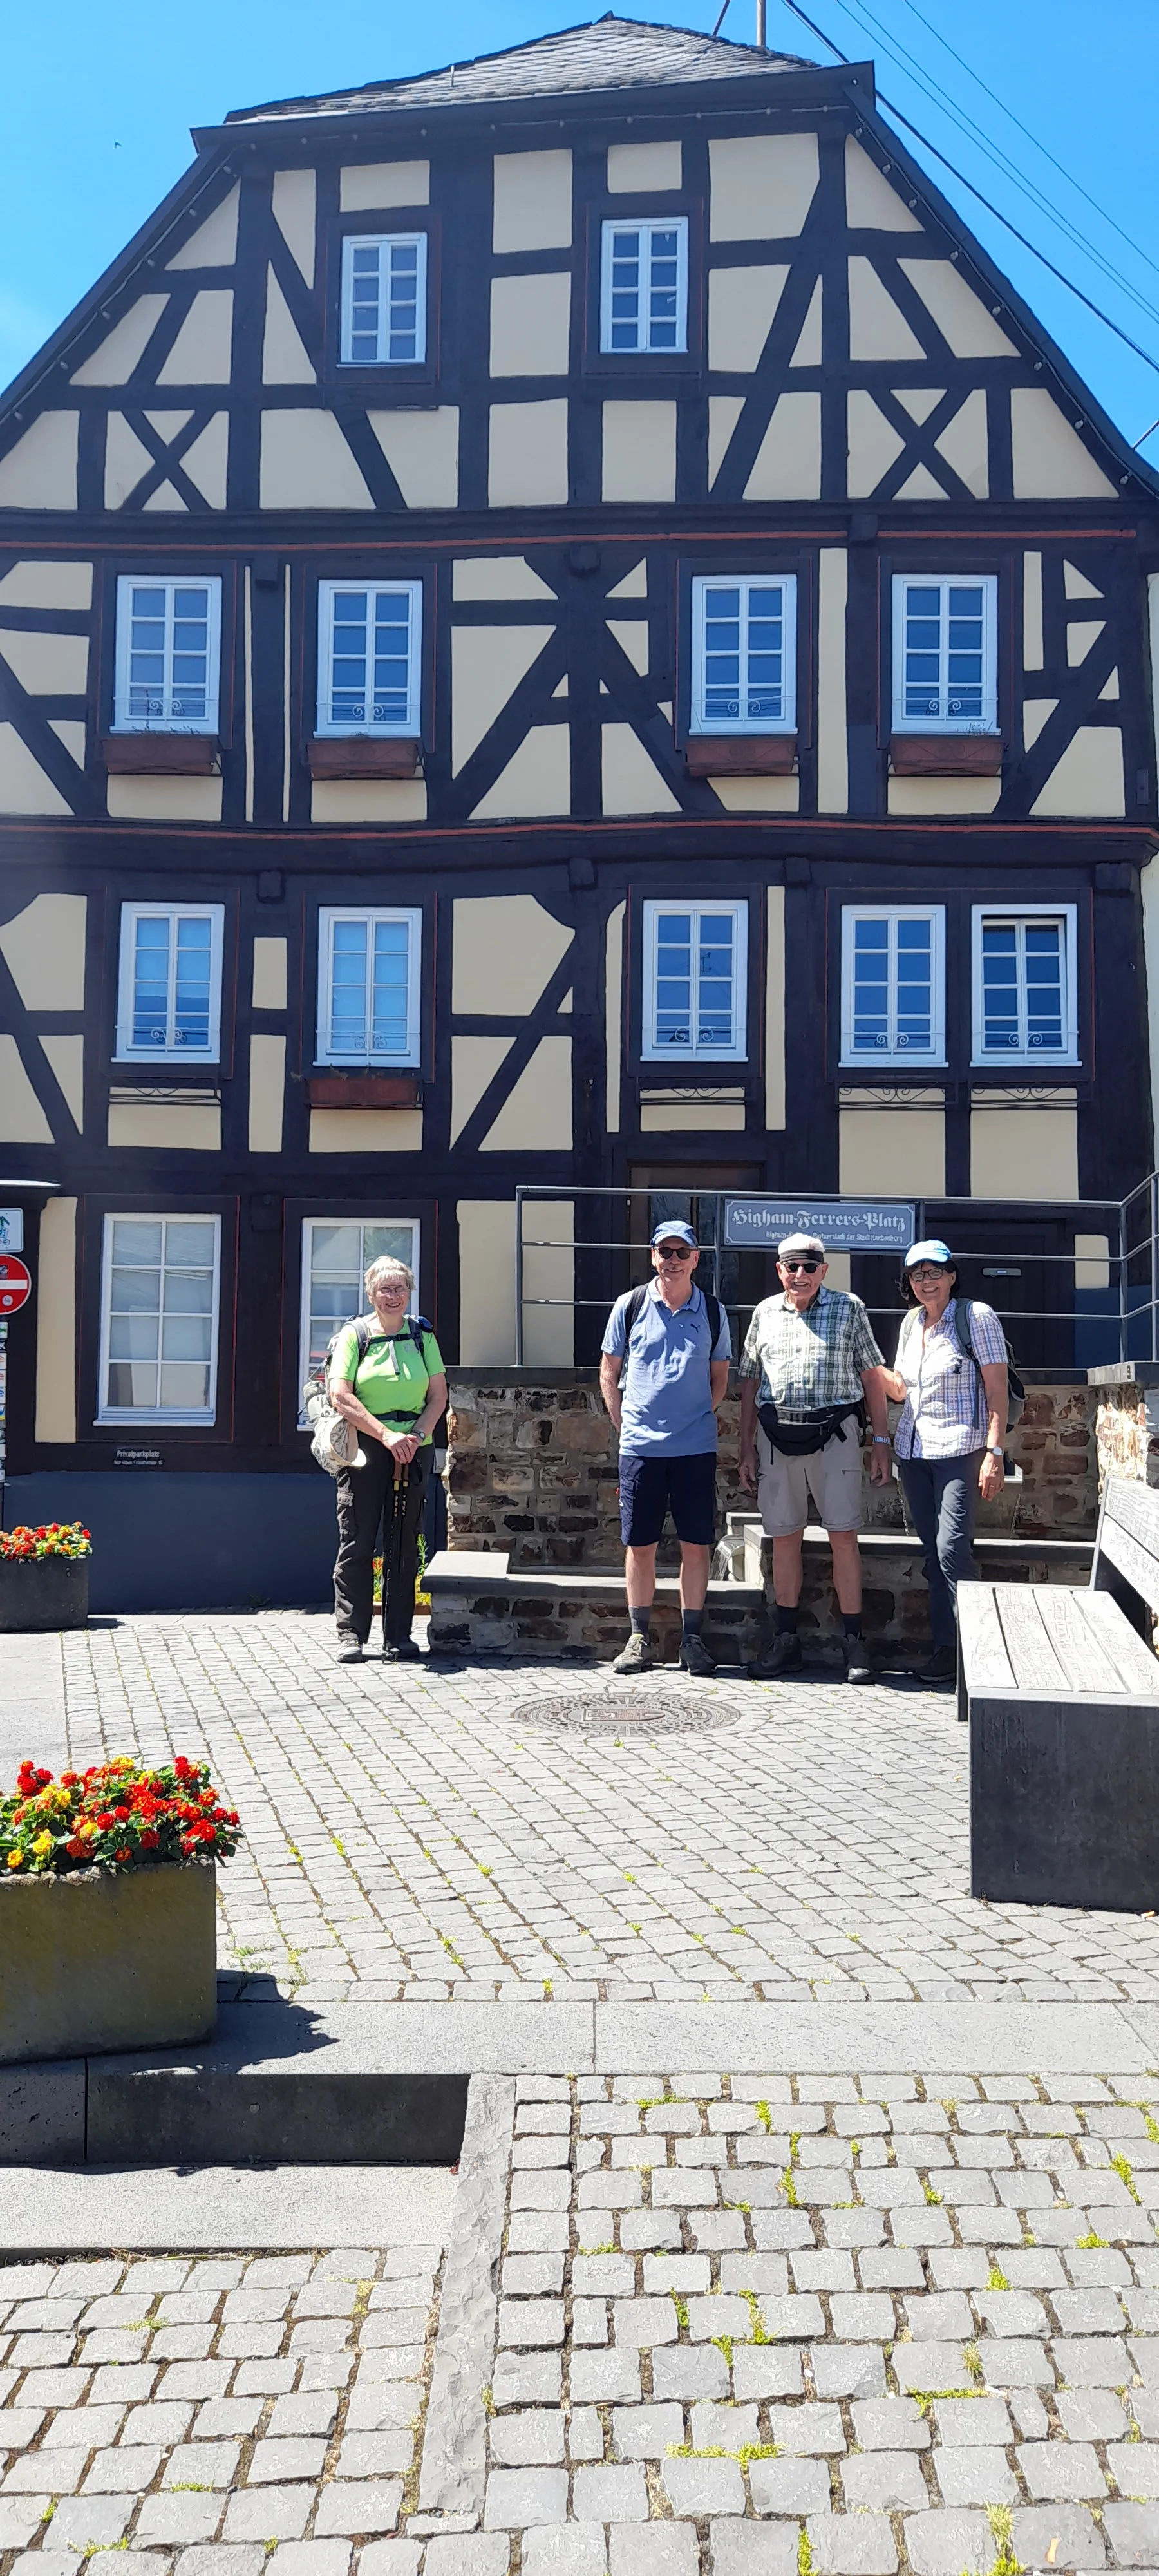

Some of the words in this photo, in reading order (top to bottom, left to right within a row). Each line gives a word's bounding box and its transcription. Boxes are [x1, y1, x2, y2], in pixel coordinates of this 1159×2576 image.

[731, 1208, 905, 1233] Higham-Ferrers-Platz
[871, 1235, 903, 1244] Hachenburg
[117, 1450, 160, 1459] Privatparkplatz
